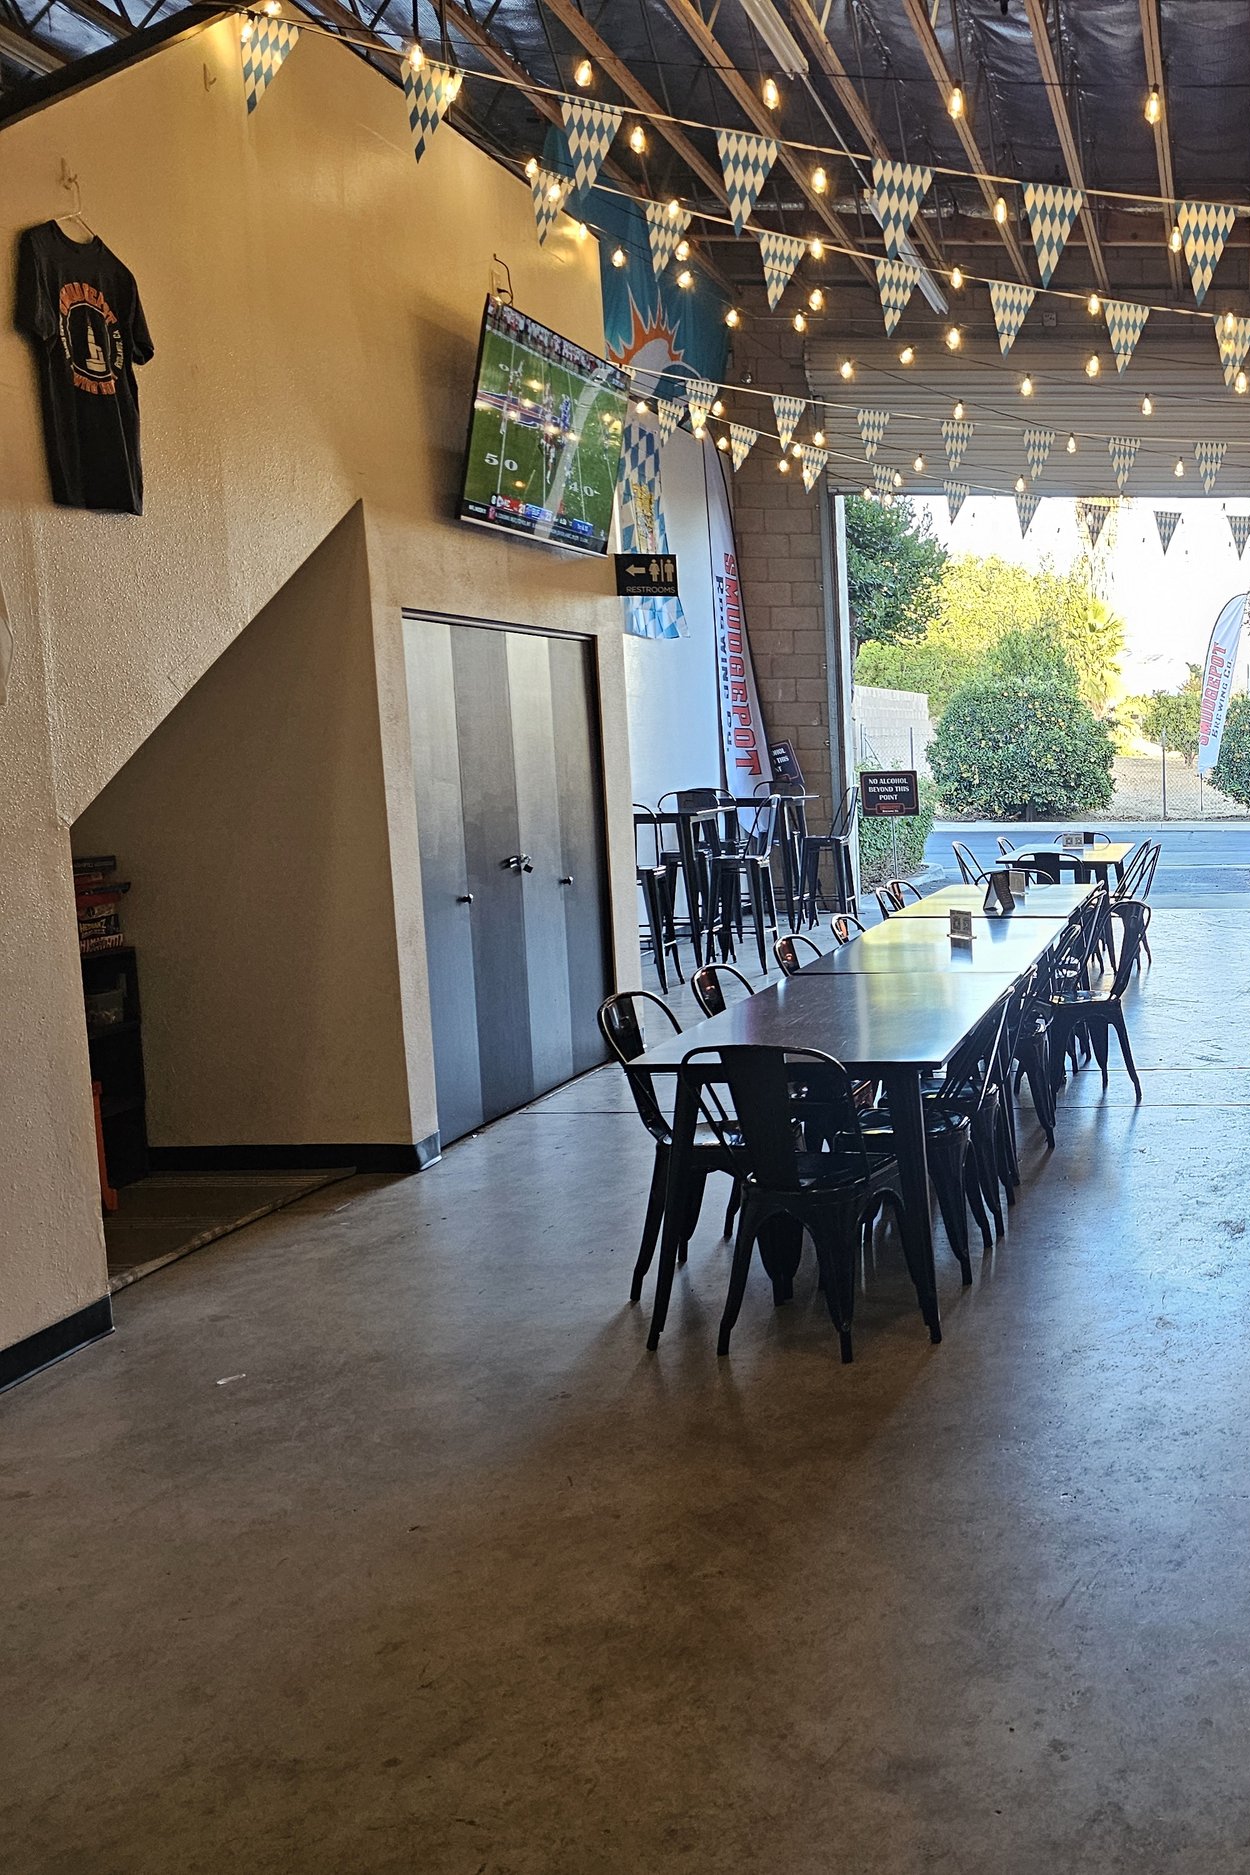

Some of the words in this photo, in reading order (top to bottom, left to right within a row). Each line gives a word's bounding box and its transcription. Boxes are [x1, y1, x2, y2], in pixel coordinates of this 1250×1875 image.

[625, 585, 676, 595] RESTROOMS
[723, 551, 763, 776] SMUDGEPOT
[1199, 641, 1227, 747] SMUDGEPOT
[1211, 683, 1228, 740] BREWING
[879, 777, 909, 785] ALCOHOL
